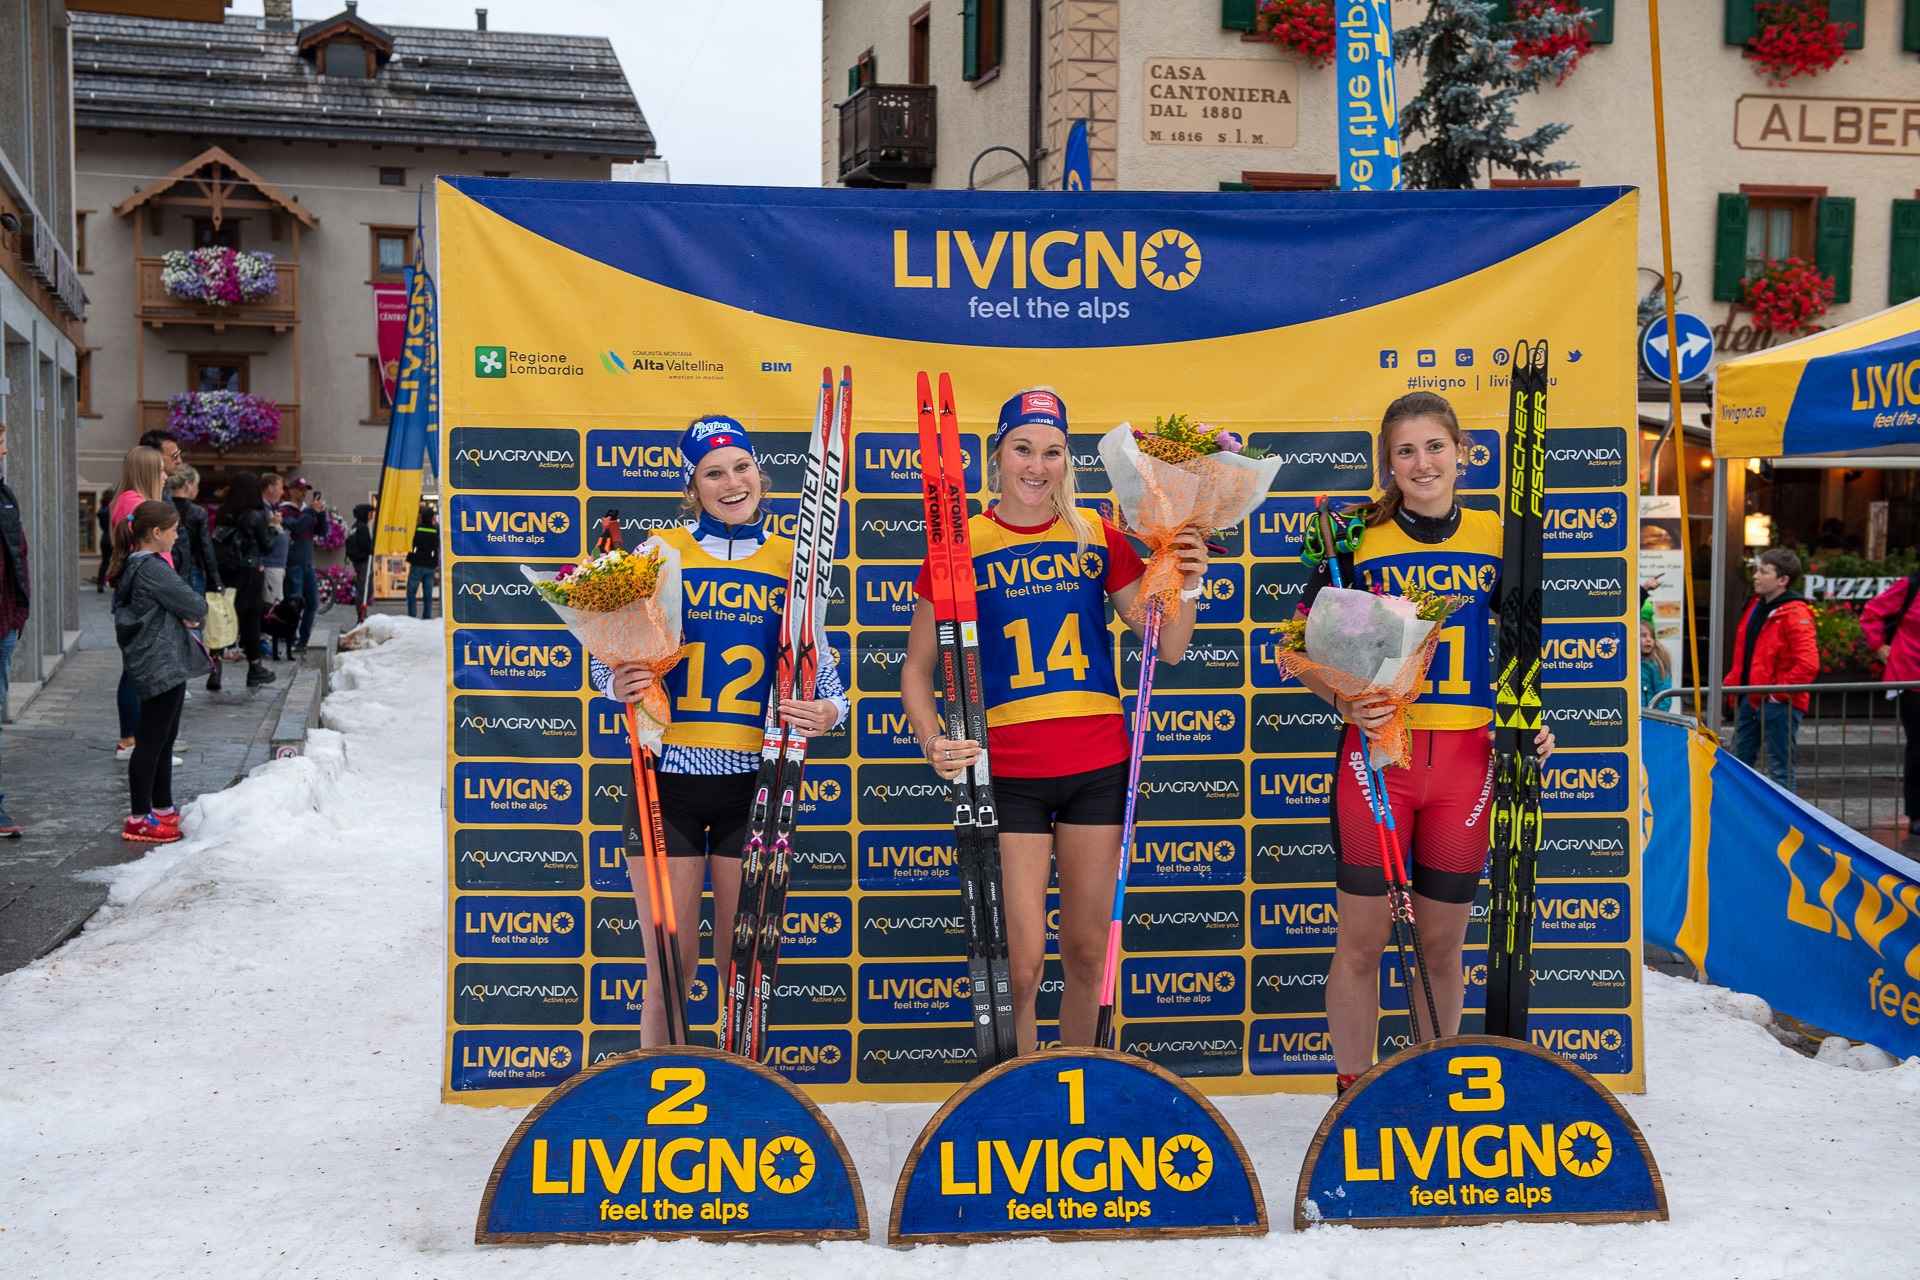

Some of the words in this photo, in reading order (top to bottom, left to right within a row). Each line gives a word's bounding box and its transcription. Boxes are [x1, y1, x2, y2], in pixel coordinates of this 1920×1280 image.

[1151, 65, 1207, 81] CASA
[1150, 84, 1292, 104] CANTONIERA
[1150, 104, 1188, 118] DAL
[1202, 107, 1242, 120] 1880
[1171, 132, 1203, 142] 1816
[894, 229, 1202, 291] LIVIGNO
[969, 296, 1020, 318] feel
[1026, 297, 1069, 318] the
[1078, 297, 1130, 324] alps
[509, 352, 566, 364] Regione
[633, 359, 664, 371] Alta
[666, 360, 724, 372] Valtellina
[510, 364, 584, 376] Lombardia
[762, 362, 792, 373] BIM
[1407, 375, 1466, 390] #livigno
[1722, 404, 1766, 424] livigno.eu
[1873, 412, 1894, 428] feel
[1897, 411, 1914, 426] the
[455, 449, 574, 467] AQUAGRANDA
[1511, 391, 1529, 517] FISCHER
[1531, 391, 1547, 518] FISCHER
[623, 469, 641, 478] feel
[643, 469, 659, 478] the
[662, 470, 680, 479] alps
[461, 511, 570, 534] LIVIGNO
[927, 484, 943, 544] ATOMIC
[949, 484, 964, 545] ATOMIC
[793, 452, 821, 600] PELTONEN
[814, 450, 841, 600] PELTONEN
[487, 534, 506, 542] feel
[508, 534, 524, 543] the
[526, 535, 545, 544] alps
[1558, 531, 1572, 539] the
[1574, 532, 1593, 540] alps
[974, 551, 1104, 593] LIVIGNO
[1005, 588, 1029, 599] feel
[1032, 584, 1052, 595] the
[1056, 581, 1080, 593] alps
[688, 608, 712, 620] feel
[714, 610, 736, 621] the
[739, 612, 763, 624] alps
[464, 645, 572, 667] LIVIGNO
[1003, 613, 1090, 689] 14
[490, 668, 508, 677] feel
[510, 668, 525, 677] the
[528, 669, 546, 678] alps
[1574, 662, 1593, 670] alps
[676, 641, 766, 716] 12
[944, 652, 956, 702] REDSTER
[967, 653, 979, 703] REDSTER
[460, 717, 576, 734] AQUAGRANDA
[1156, 732, 1174, 741] feel
[1176, 732, 1191, 741] the
[1193, 733, 1211, 742] alps
[465, 779, 572, 801] LIVIGNO
[1559, 791, 1574, 799] the
[1575, 792, 1594, 800] alps
[491, 801, 508, 810] feel
[511, 801, 526, 810] the
[529, 802, 547, 811] alps
[1286, 796, 1303, 805] feel
[1306, 796, 1320, 804] the
[461, 851, 578, 868] AQUAGRANDA
[1132, 840, 1235, 862] LIVIGNO
[894, 868, 911, 877] feel
[913, 868, 929, 877] the
[932, 868, 949, 878] alps
[1156, 864, 1174, 873] feel
[1176, 864, 1191, 872] the
[1193, 865, 1211, 873] alps
[465, 911, 575, 934] LIVIGNO
[1128, 912, 1239, 930] AQUAGRANDA
[1286, 926, 1303, 934] feel
[1306, 926, 1321, 934] the
[1542, 921, 1558, 929] feel
[1560, 921, 1575, 929] the
[1576, 922, 1596, 930] alps
[492, 935, 509, 944] feel
[512, 935, 527, 944] the
[530, 935, 549, 945] alps
[800, 936, 817, 945] alps
[736, 974, 746, 1001] 181
[762, 974, 771, 1001] 181
[868, 977, 972, 1000] LIVIGNO
[1131, 971, 1235, 994] LIVIGNO
[460, 985, 578, 1002] AQUAGRANDA
[1156, 995, 1174, 1004] feel
[1176, 995, 1191, 1004] the
[1193, 995, 1211, 1004] alps
[894, 1001, 911, 1010] feel
[913, 1001, 929, 1009] the
[932, 1001, 949, 1011] alps
[463, 1045, 572, 1069] LIVIGNO
[864, 1048, 977, 1064] AQUAGRANDA
[1126, 1040, 1236, 1057] AQUAGRANDA
[1283, 1053, 1301, 1062] feel
[1303, 1053, 1318, 1062] the
[488, 1069, 506, 1078] feel
[508, 1069, 524, 1078] the
[527, 1069, 545, 1079] alps
[1448, 1056, 1505, 1112] 3
[648, 1067, 708, 1126] 2
[1057, 1068, 1085, 1125] 1
[1344, 1121, 1612, 1181] LIVIGNO
[532, 1136, 816, 1196] LIVIGNO
[940, 1134, 1214, 1197] LIVIGNO
[1410, 1184, 1456, 1207] feel
[1460, 1184, 1499, 1205] the
[1506, 1183, 1552, 1207] alps
[600, 1198, 647, 1221] feel
[654, 1199, 695, 1221] the
[701, 1199, 749, 1225] alps
[1007, 1197, 1055, 1221] feel
[1060, 1198, 1101, 1220] the
[1106, 1198, 1152, 1223] alps
